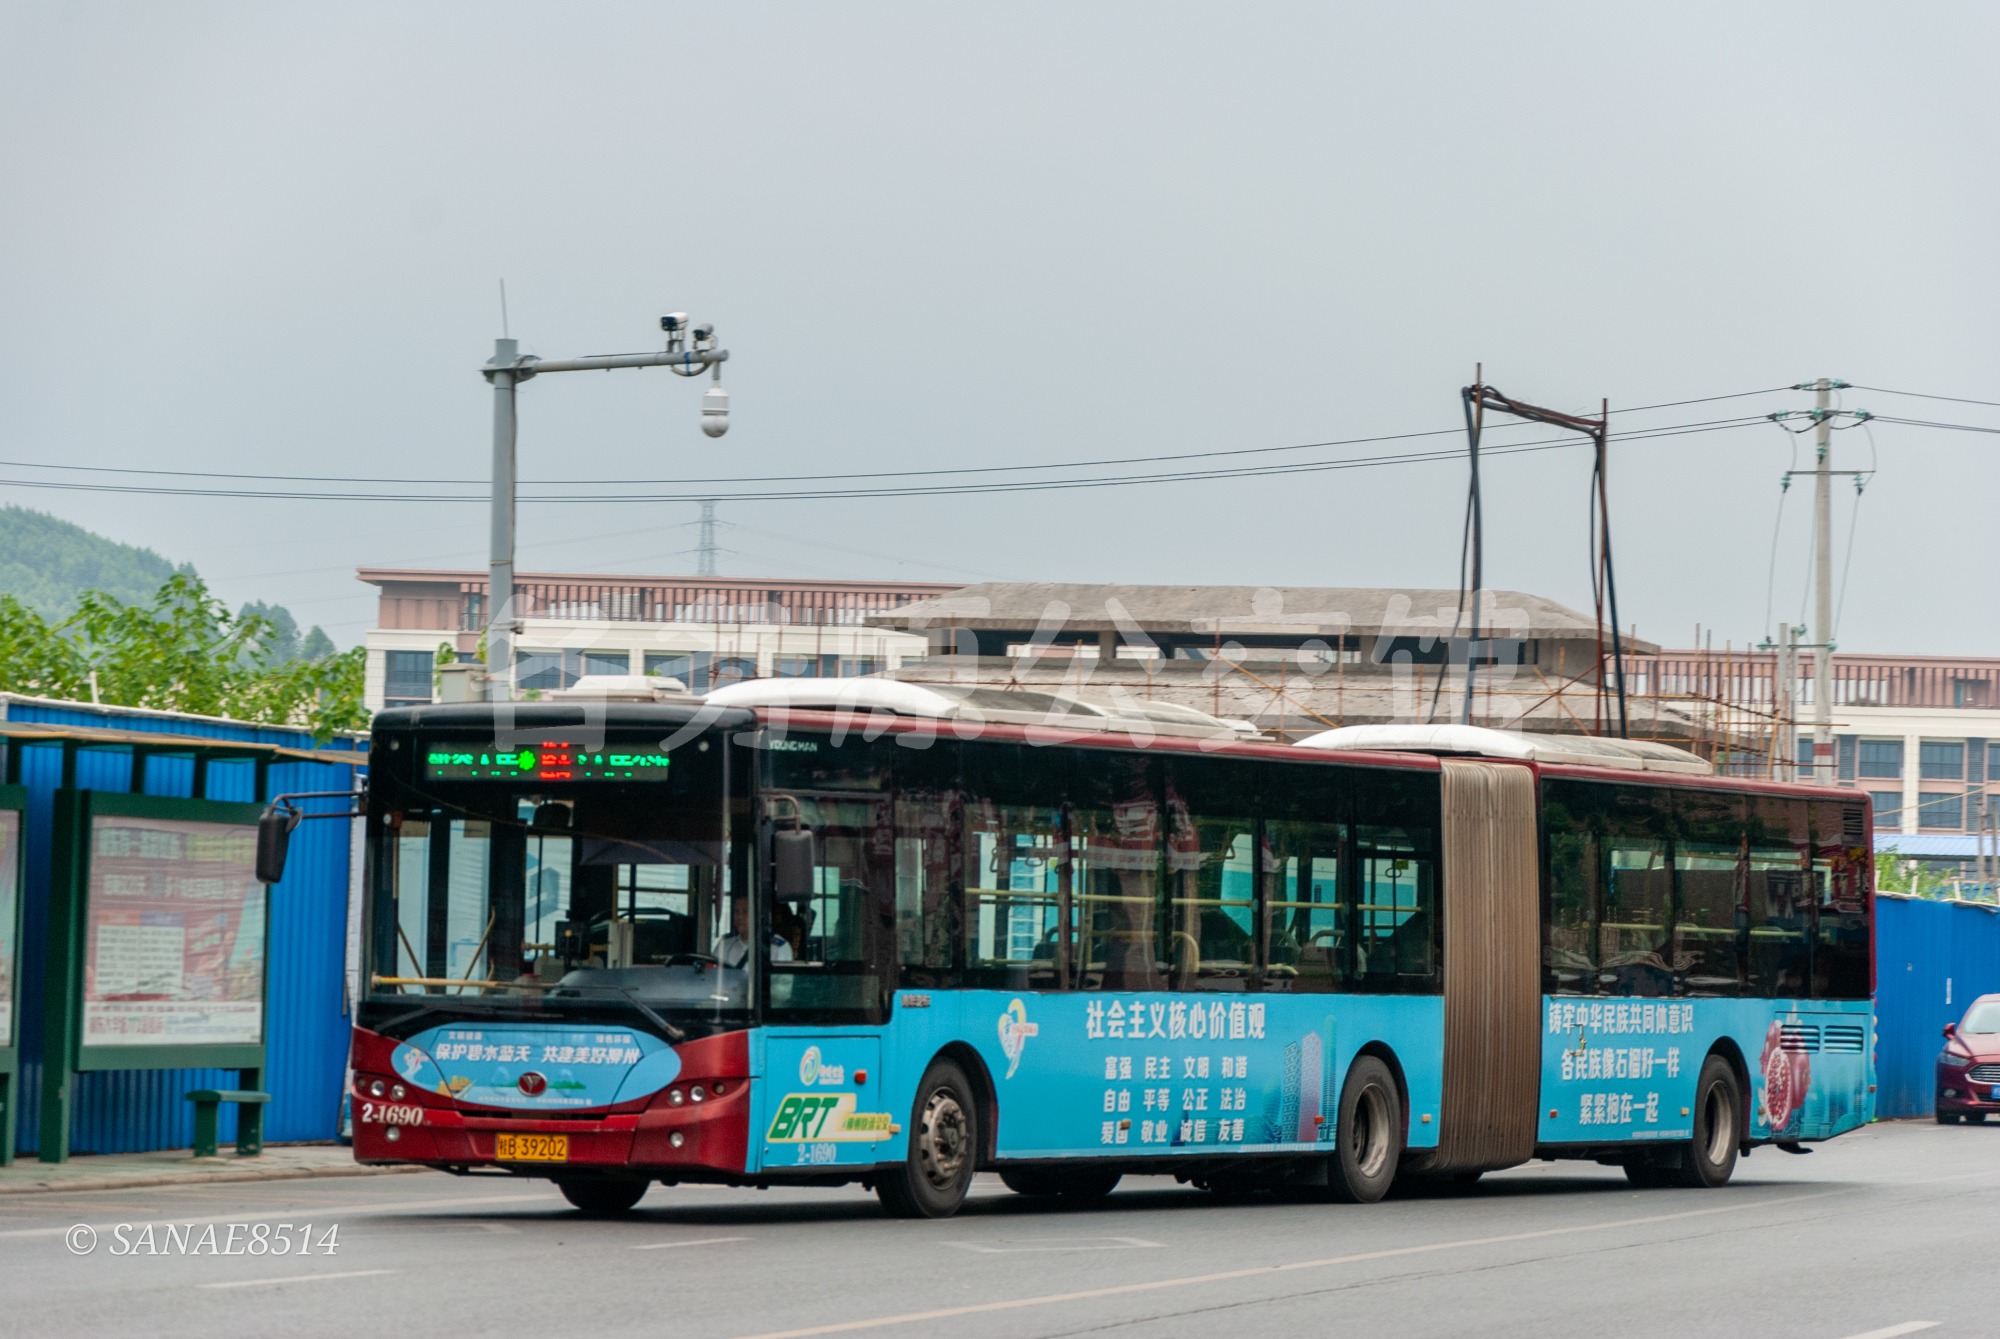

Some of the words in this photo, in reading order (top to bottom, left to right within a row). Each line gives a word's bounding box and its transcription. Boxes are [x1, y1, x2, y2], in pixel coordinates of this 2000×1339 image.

[1086, 1000, 1266, 1040] 社会主义核心价值观
[1549, 1002, 1694, 1035] 铸牢中华民族共同体意识
[436, 1043, 531, 1063] 保护碧水蓝天
[541, 1045, 641, 1066] 共建美好柳州
[1561, 1047, 1681, 1081] 各民族像石榴籽一样
[1105, 1056, 1132, 1080] 富强
[1144, 1056, 1171, 1080] 民主
[1183, 1056, 1210, 1080] 文明
[1221, 1056, 1248, 1080] 和谐
[1103, 1088, 1131, 1113] 自由
[1143, 1088, 1170, 1112] 平等
[1182, 1088, 1209, 1112] 公正
[1220, 1087, 1247, 1112] 法治
[1579, 1091, 1660, 1126] 紧紧抱在一起
[362, 1103, 424, 1127] 2-1690
[768, 1097, 840, 1139] BRT
[1141, 1120, 1169, 1144] 敬业
[1180, 1119, 1207, 1143] 诚信
[1218, 1118, 1245, 1142] 友善
[797, 1143, 837, 1163] 2-1690
